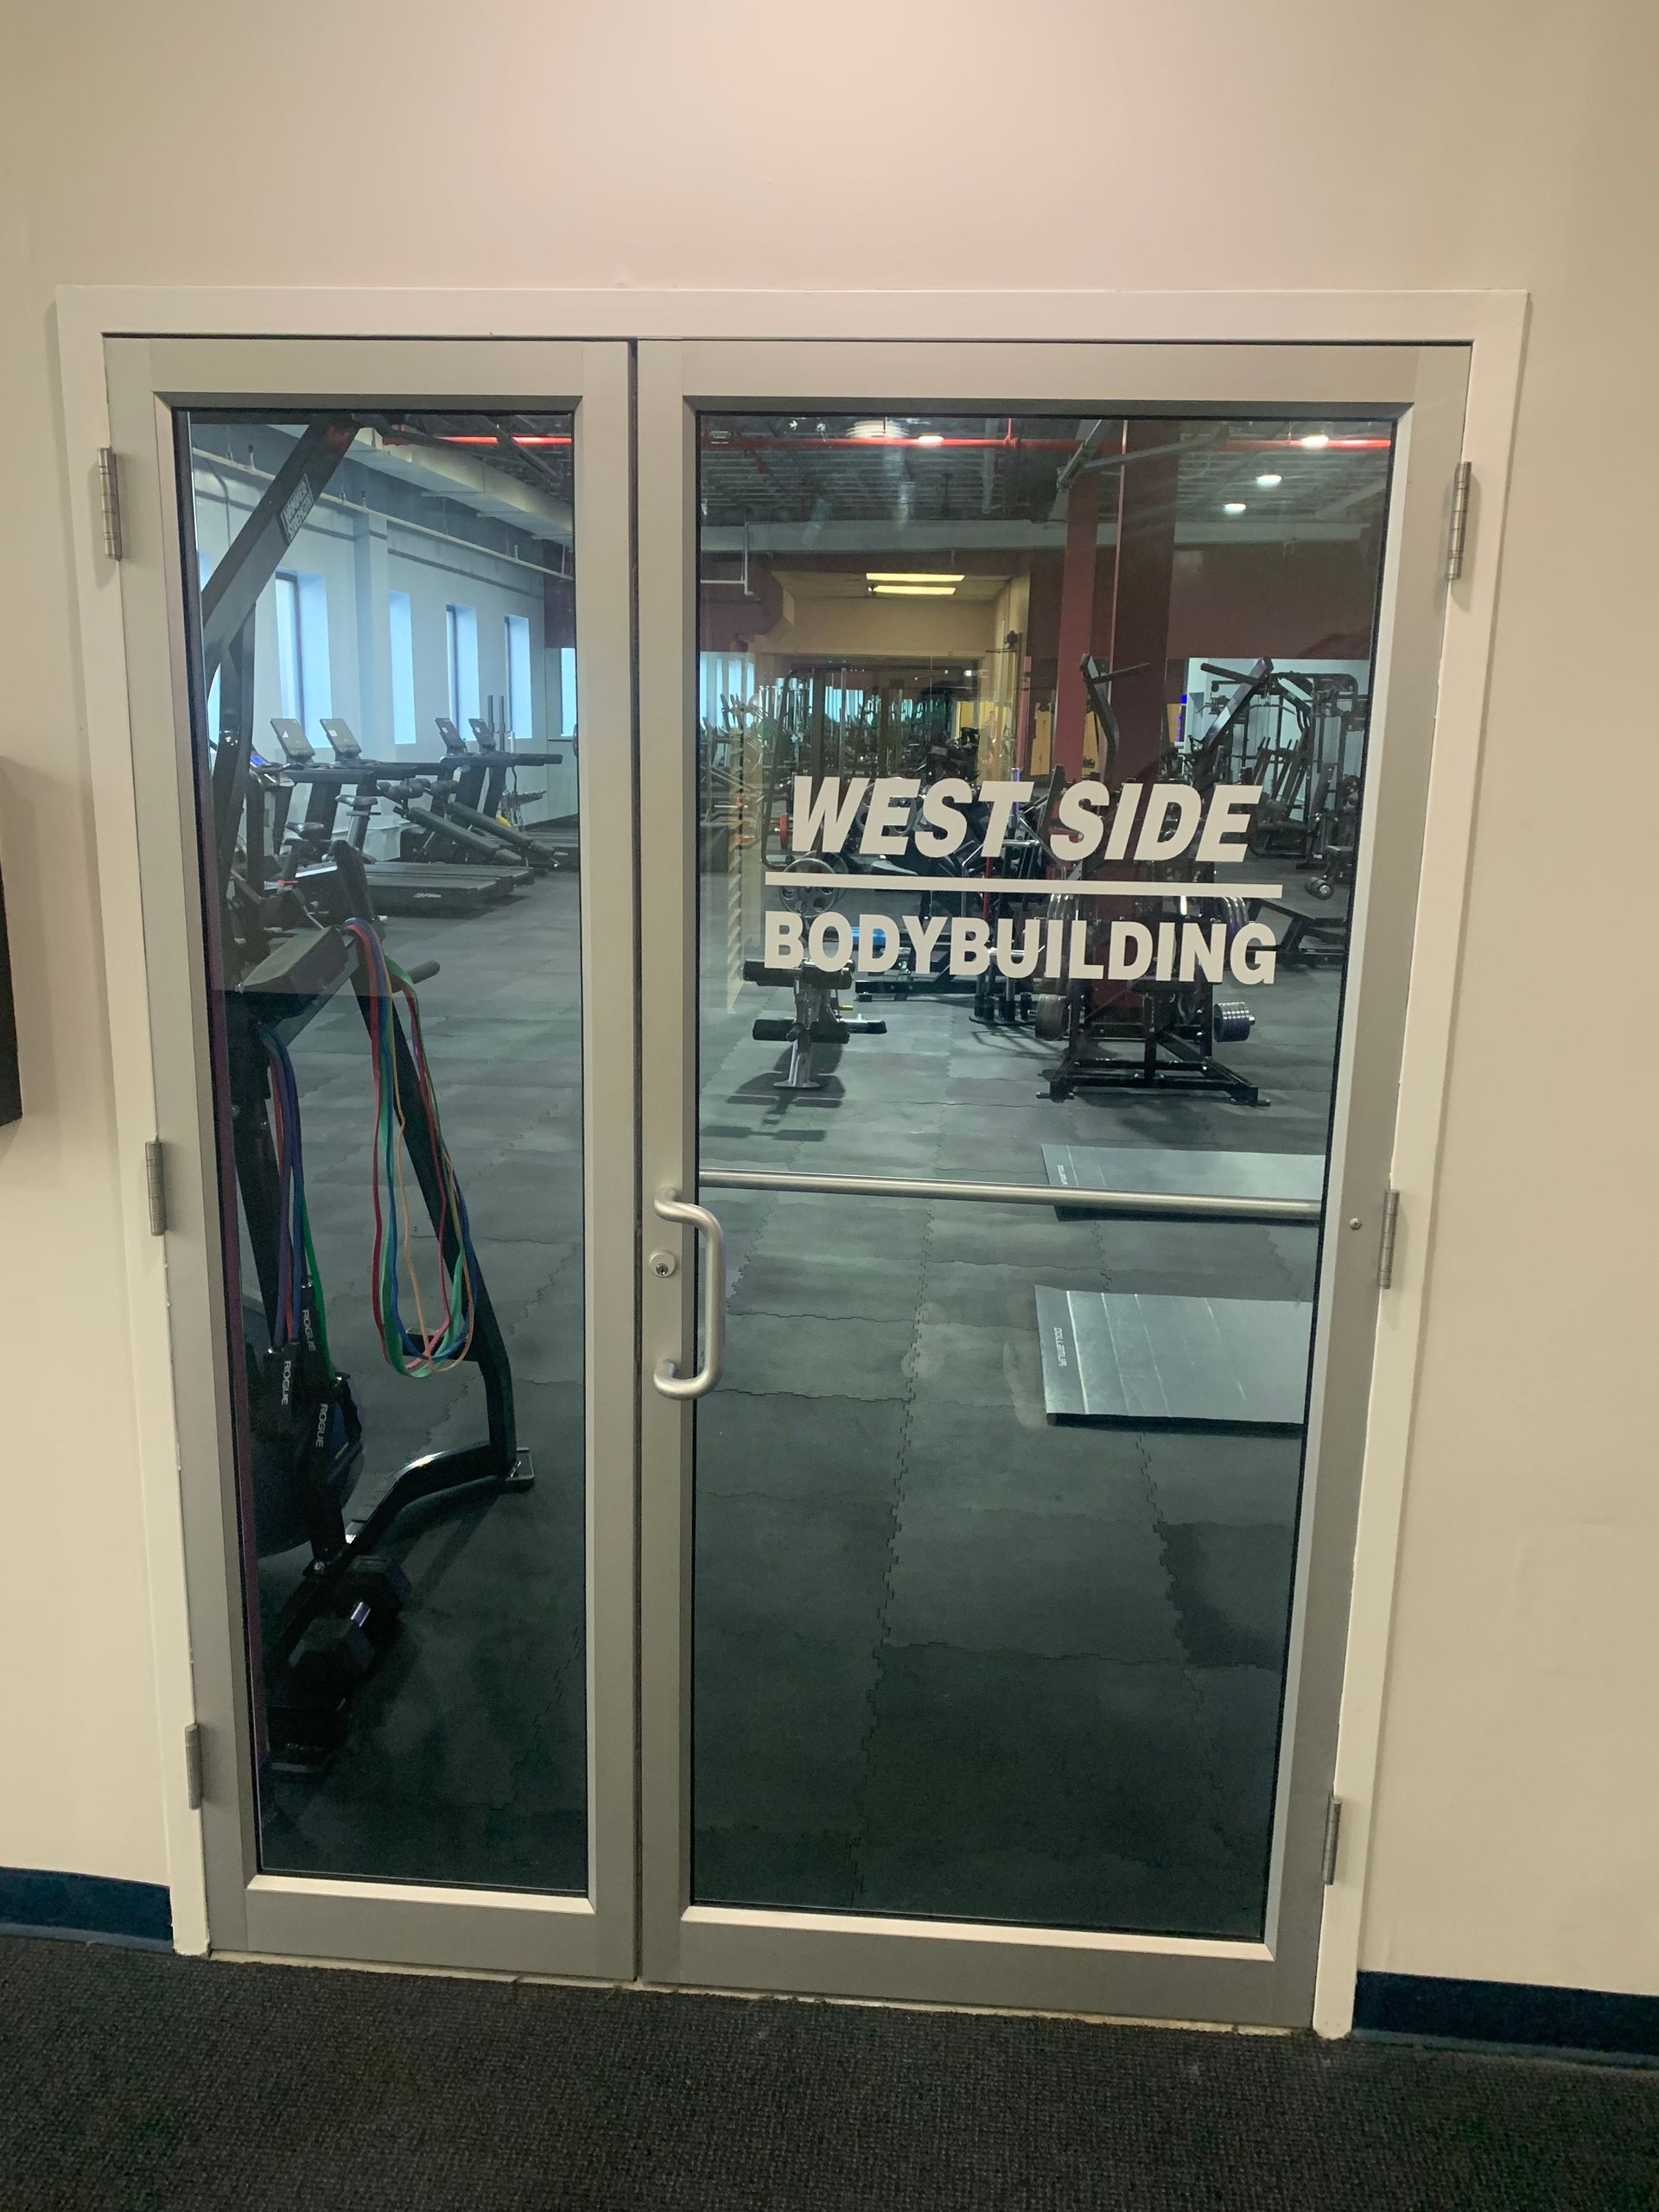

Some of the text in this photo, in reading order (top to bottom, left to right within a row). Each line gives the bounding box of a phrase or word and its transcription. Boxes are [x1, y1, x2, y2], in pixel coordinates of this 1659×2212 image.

[791, 774, 1263, 863] WEST SIDE
[763, 910, 1277, 986] BODYBUILDING
[301, 1309, 316, 1352] ROGUE
[281, 1360, 292, 1406] ROGUE
[315, 1403, 328, 1448] ROGUE
